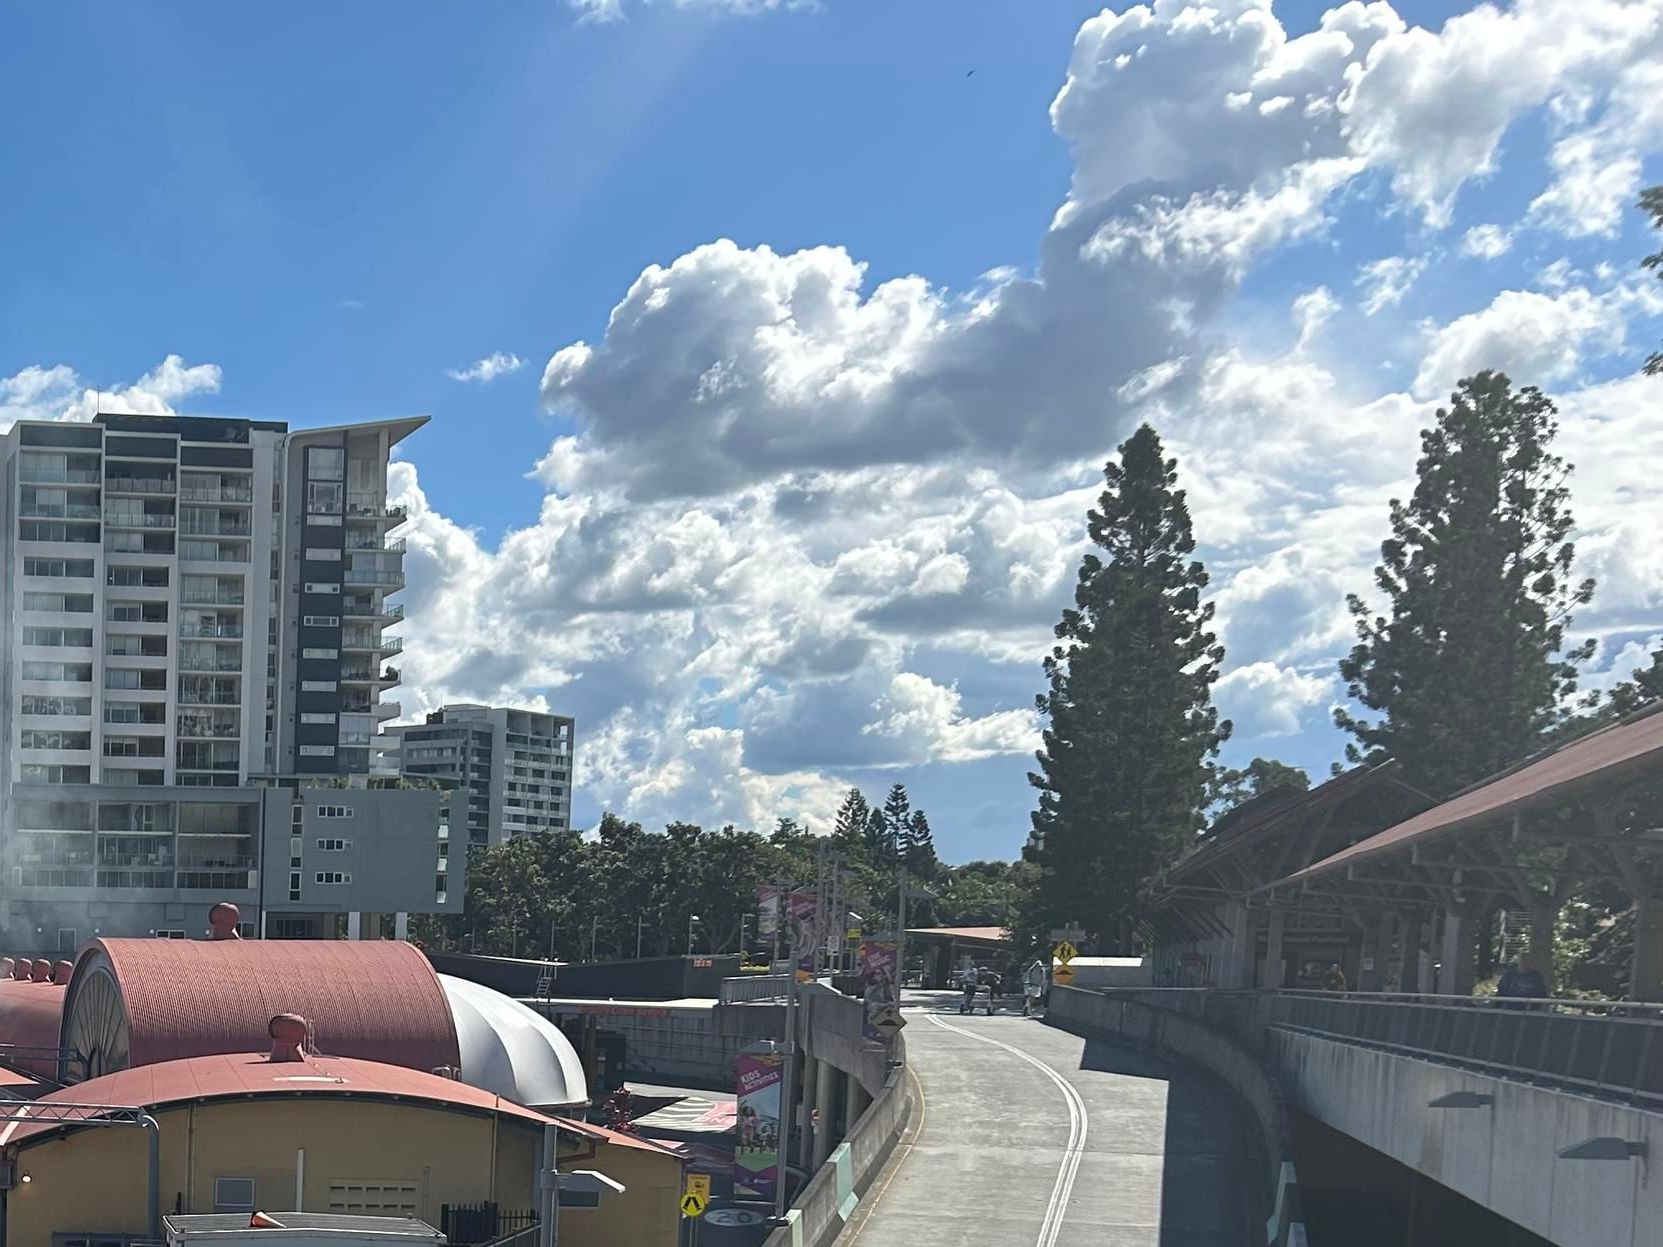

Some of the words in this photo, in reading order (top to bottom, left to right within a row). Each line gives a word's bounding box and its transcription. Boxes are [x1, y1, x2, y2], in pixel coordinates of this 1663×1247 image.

[740, 1070, 761, 1084] KIDS
[744, 1071, 779, 1091] ACTIVITIES
[716, 1212, 753, 1224] 20
